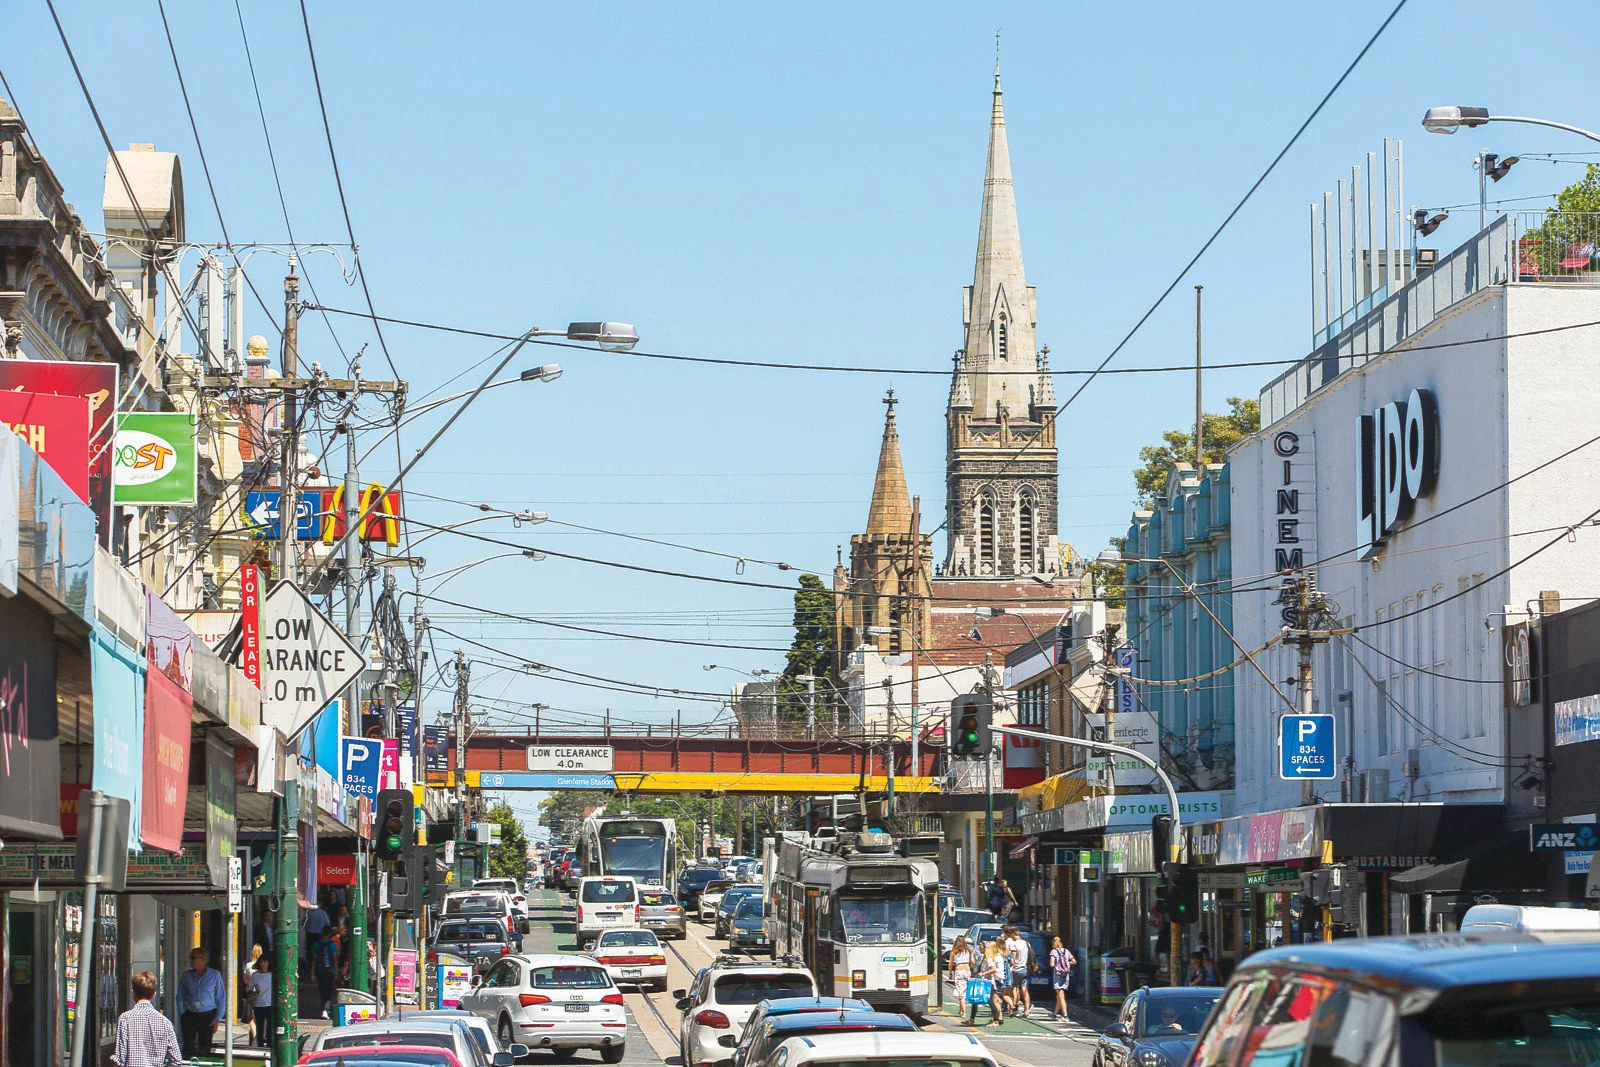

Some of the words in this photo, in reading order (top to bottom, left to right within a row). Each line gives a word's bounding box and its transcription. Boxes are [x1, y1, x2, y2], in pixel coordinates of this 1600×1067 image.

[116, 443, 173, 471] OST
[1356, 389, 1434, 560] LIDO
[246, 568, 254, 606] FOR
[267, 619, 310, 641] OW
[1113, 727, 1148, 738] enferrie
[1299, 720, 1316, 742] P
[346, 743, 369, 771] P
[532, 749, 550, 758] LOW
[555, 749, 609, 758] CLEARANCE
[1291, 756, 1325, 764] SPACES
[346, 775, 365, 785] 834
[557, 778, 591, 786] Glenferrie
[591, 778, 612, 786] Station
[344, 784, 373, 794] PACES
[1109, 802, 1218, 815] OPTOMERISTS
[1537, 833, 1576, 847] ANZ
[326, 866, 350, 875] Select
[1247, 873, 1284, 885] WAKEFIELD
[1286, 871, 1295, 880] ST
